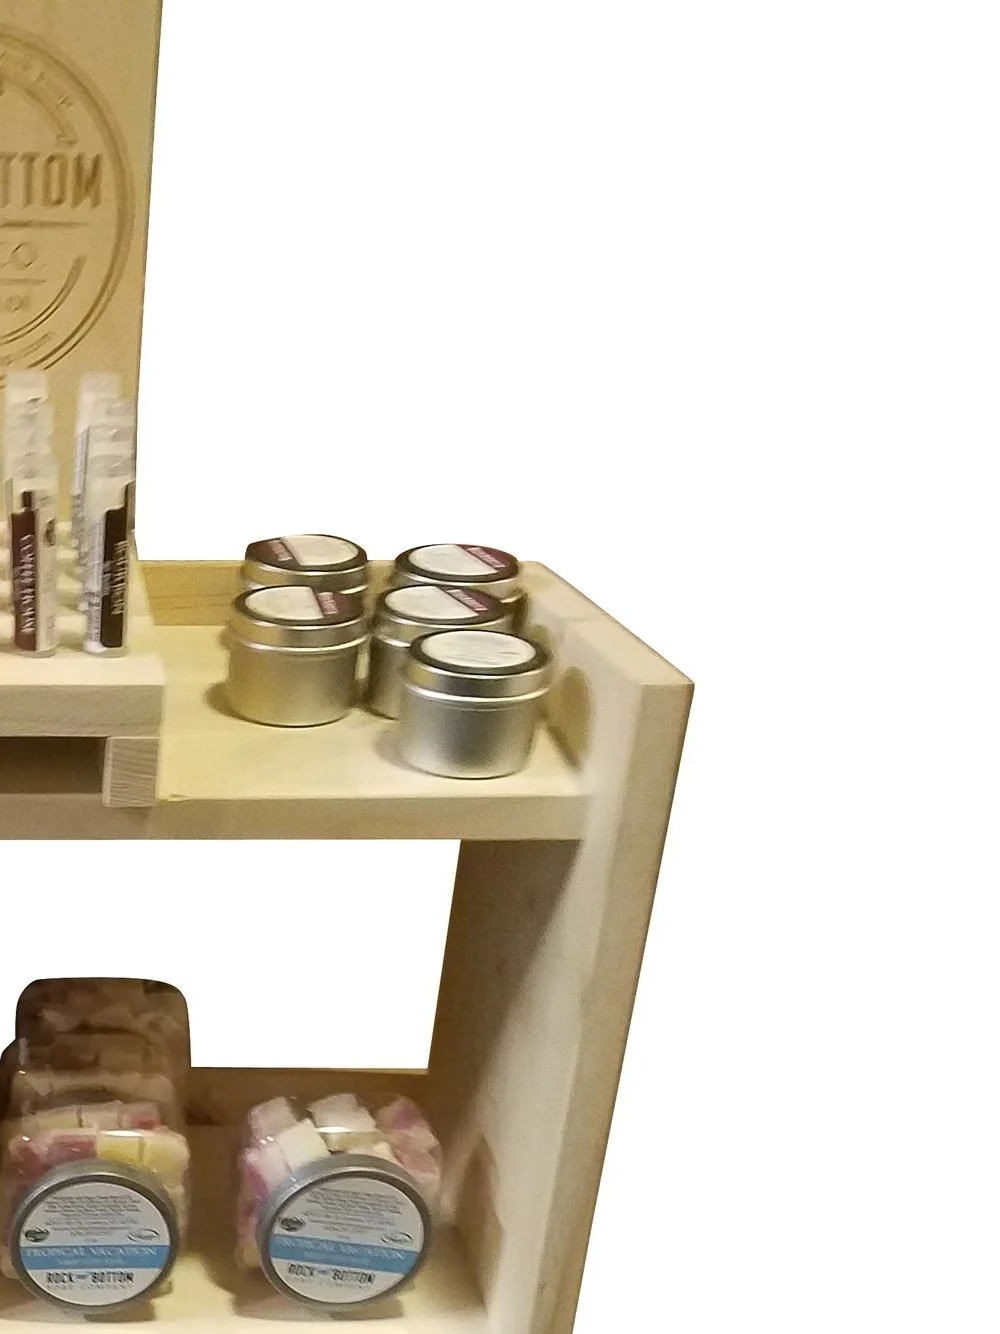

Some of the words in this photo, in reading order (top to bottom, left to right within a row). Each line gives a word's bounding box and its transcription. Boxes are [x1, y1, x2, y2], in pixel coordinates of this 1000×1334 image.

[89, 1246, 158, 1257] VACATION
[287, 1262, 315, 1277] ROCK
[45, 1271, 75, 1284] ROCK
[91, 1271, 135, 1283] BOTTOM
